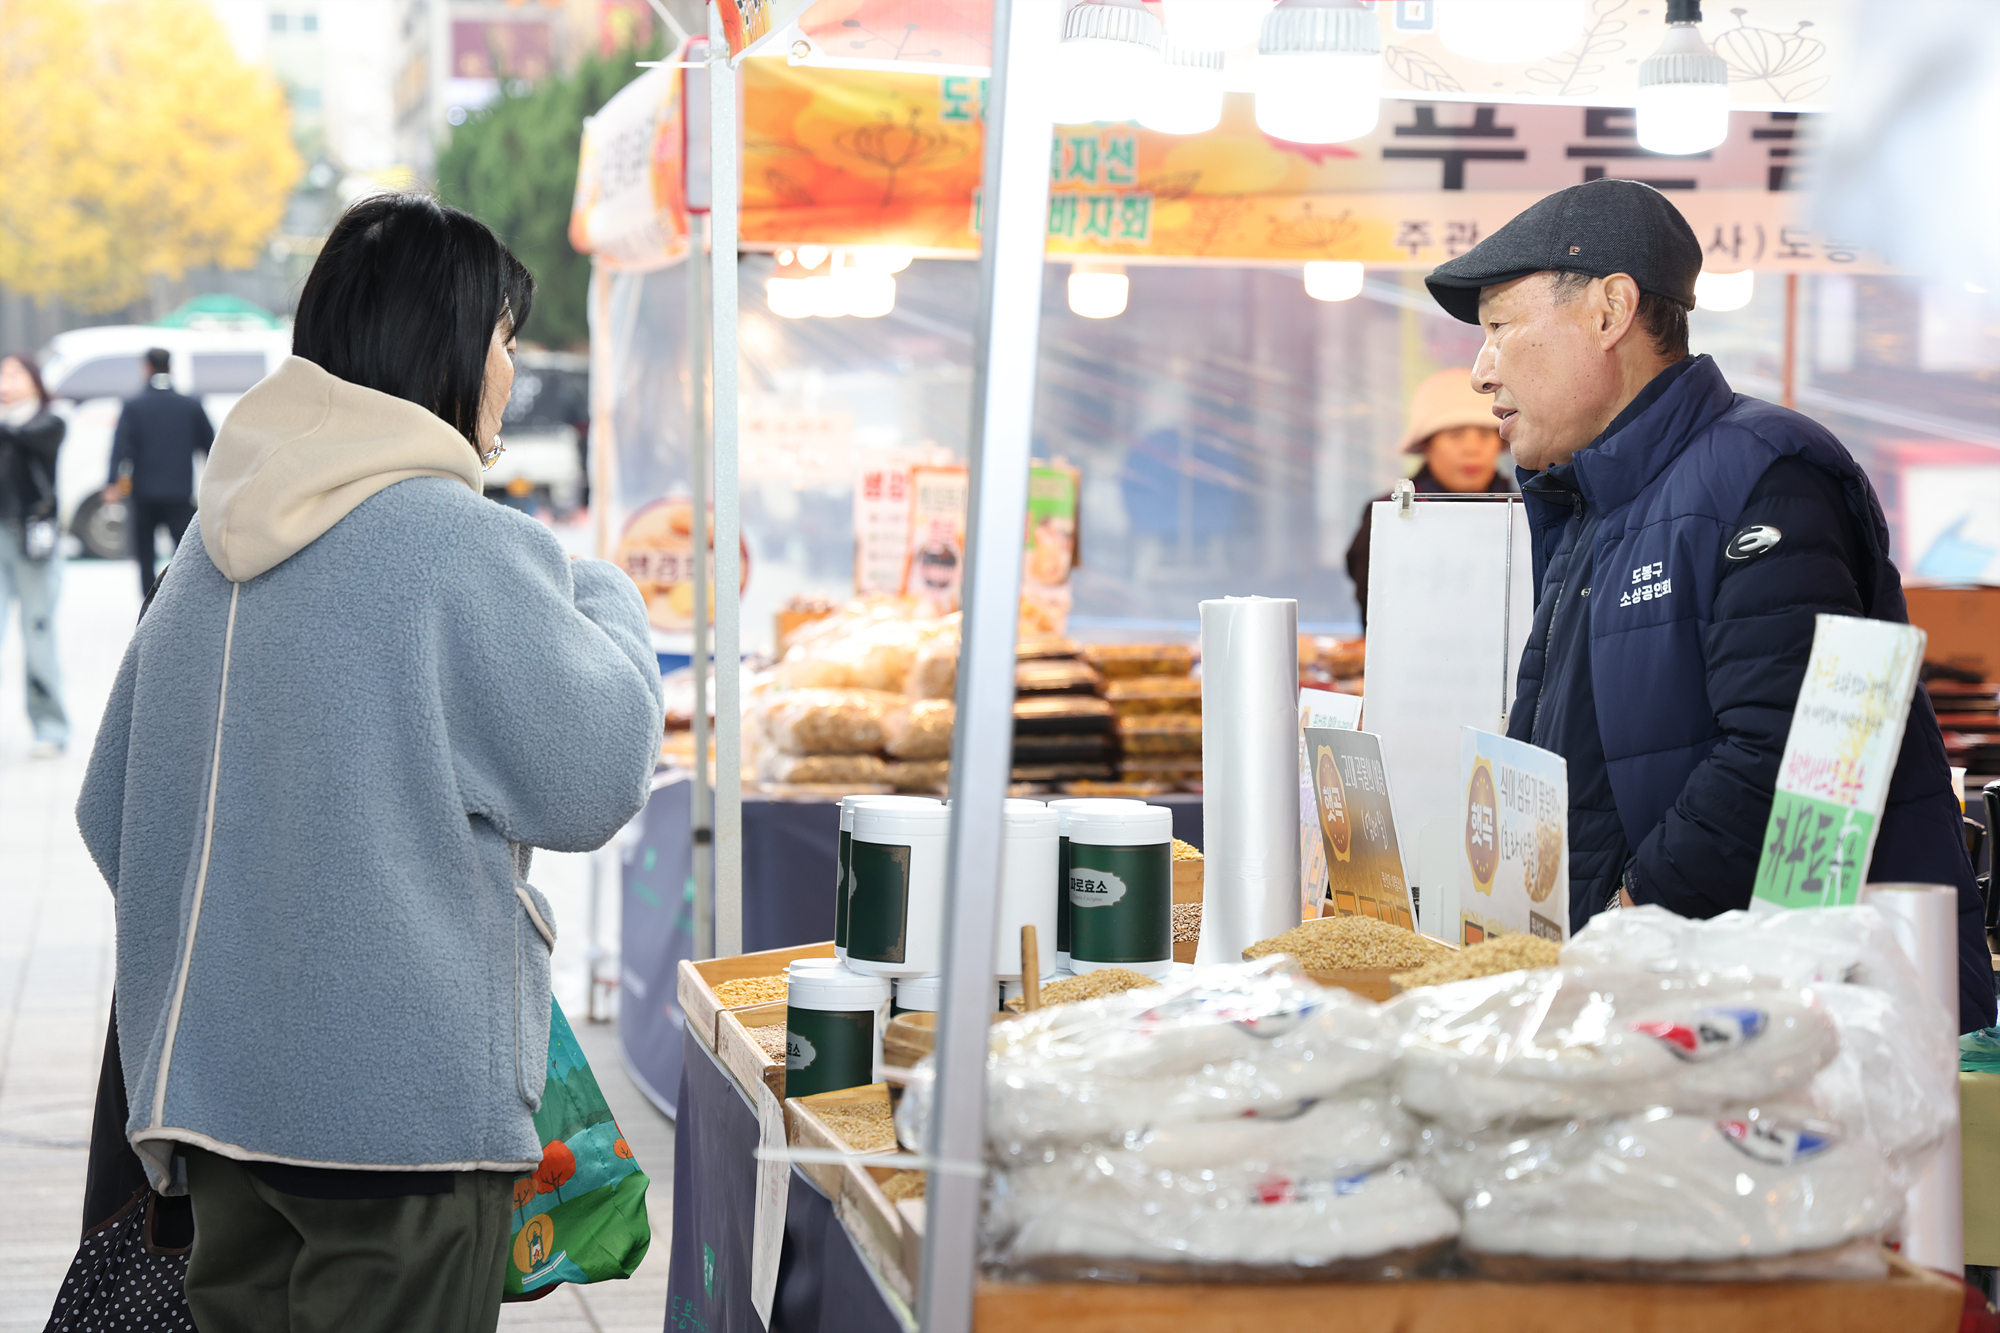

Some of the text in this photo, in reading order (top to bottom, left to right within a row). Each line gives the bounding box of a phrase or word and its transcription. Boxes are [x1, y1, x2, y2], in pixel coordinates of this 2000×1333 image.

[1631, 561, 1663, 585] 도봉구
[1620, 578, 1672, 607] 소상공인회
[1322, 786, 1345, 824] 햇곡
[1501, 766, 1515, 810] 식이
[1517, 771, 1538, 819] 섬유가
[1471, 802, 1494, 851] 햇곡
